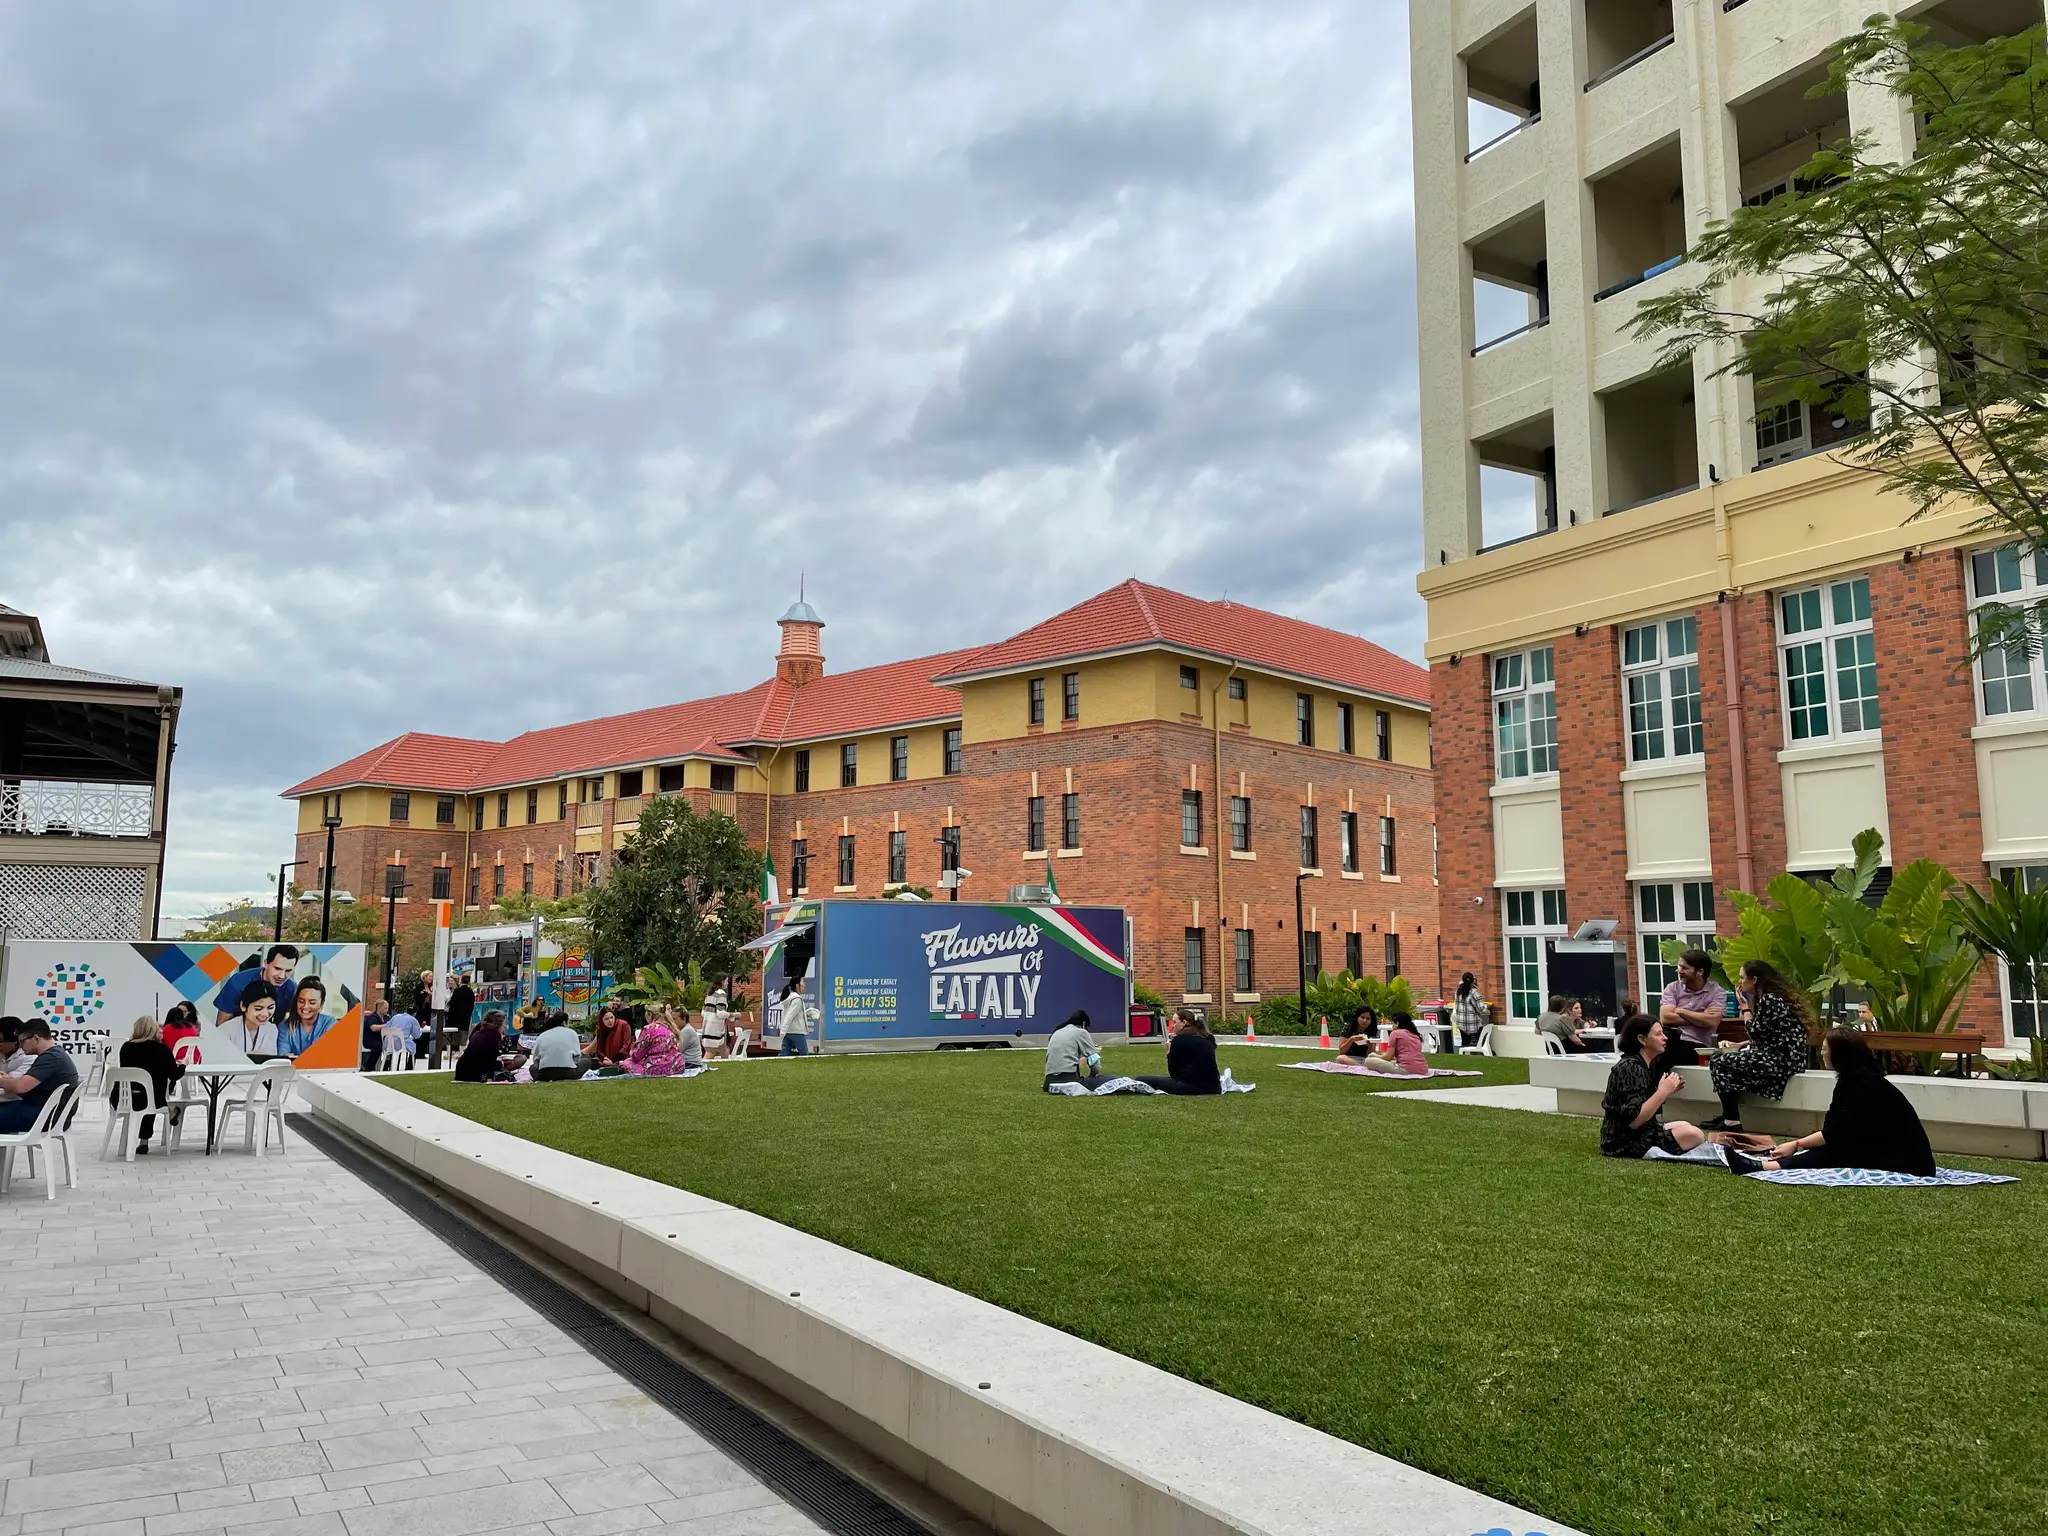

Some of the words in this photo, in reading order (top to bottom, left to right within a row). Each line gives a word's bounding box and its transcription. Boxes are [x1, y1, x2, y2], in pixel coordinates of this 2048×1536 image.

[920, 922, 1043, 968] Flavours
[1023, 949, 1044, 971] Of
[847, 978, 872, 986] FLAVOURS
[847, 988, 872, 996] FLAVOURS
[929, 974, 1042, 1019] EATALY
[835, 997, 859, 1008] 0402
[862, 997, 876, 1008] 147
[878, 996, 897, 1008] 359
[50, 1029, 110, 1041] RSTON
